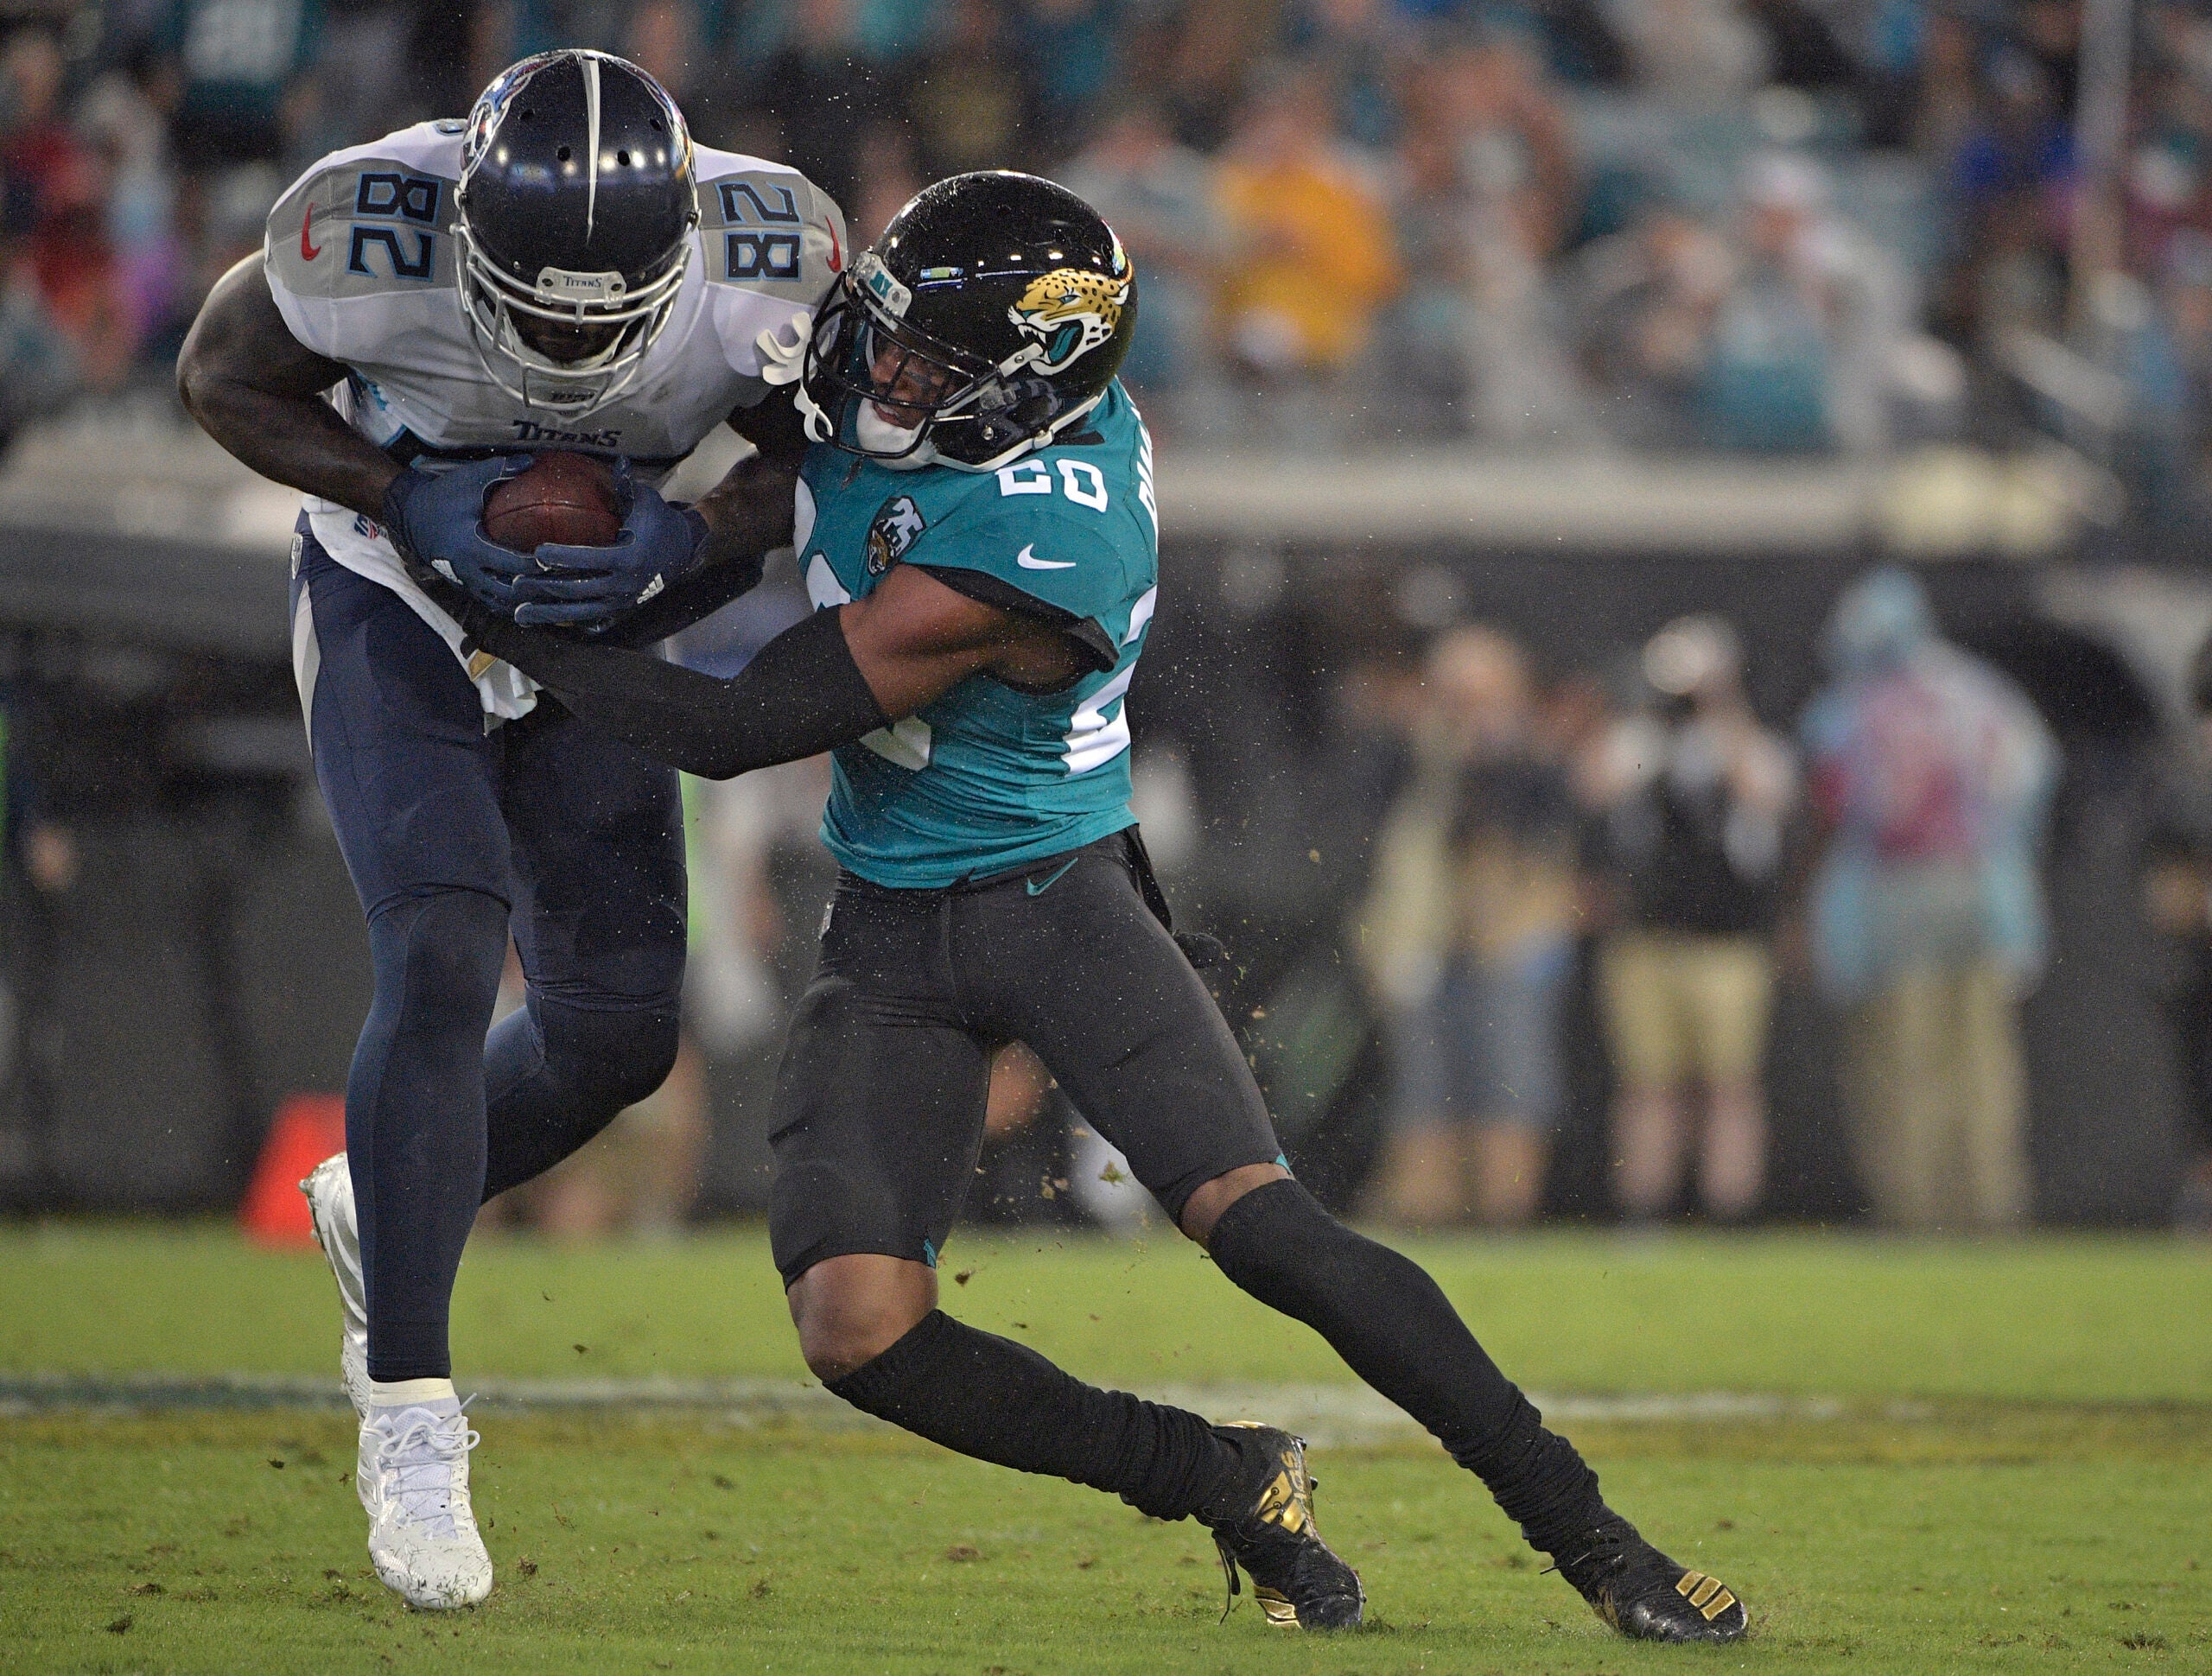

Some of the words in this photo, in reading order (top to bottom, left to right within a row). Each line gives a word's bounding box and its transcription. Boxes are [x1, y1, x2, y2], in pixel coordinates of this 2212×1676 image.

[346, 171, 442, 283] 82
[715, 177, 804, 283] 82
[512, 419, 622, 448] TITANS
